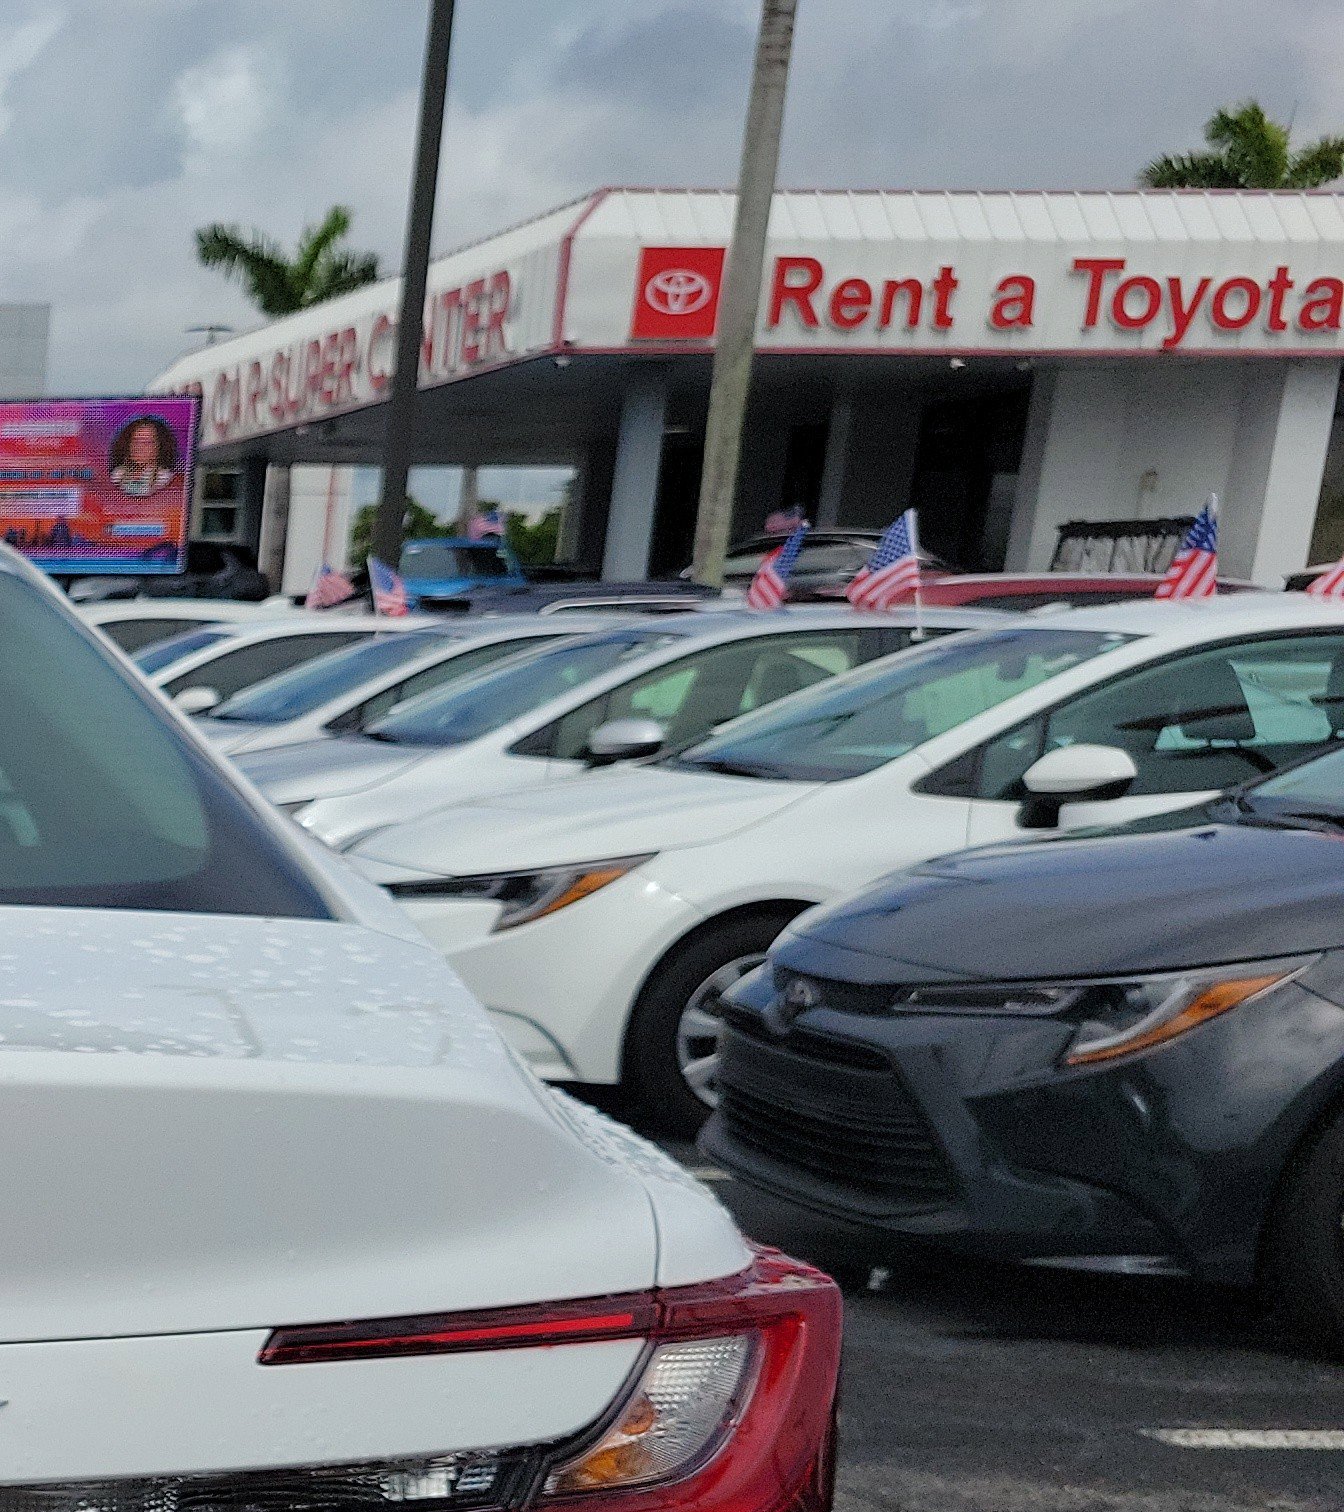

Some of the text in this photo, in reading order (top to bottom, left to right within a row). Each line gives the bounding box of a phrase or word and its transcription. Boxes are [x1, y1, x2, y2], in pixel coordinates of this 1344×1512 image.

[367, 269, 510, 390] CNTER
[766, 256, 1344, 352] Rent a Toyota
